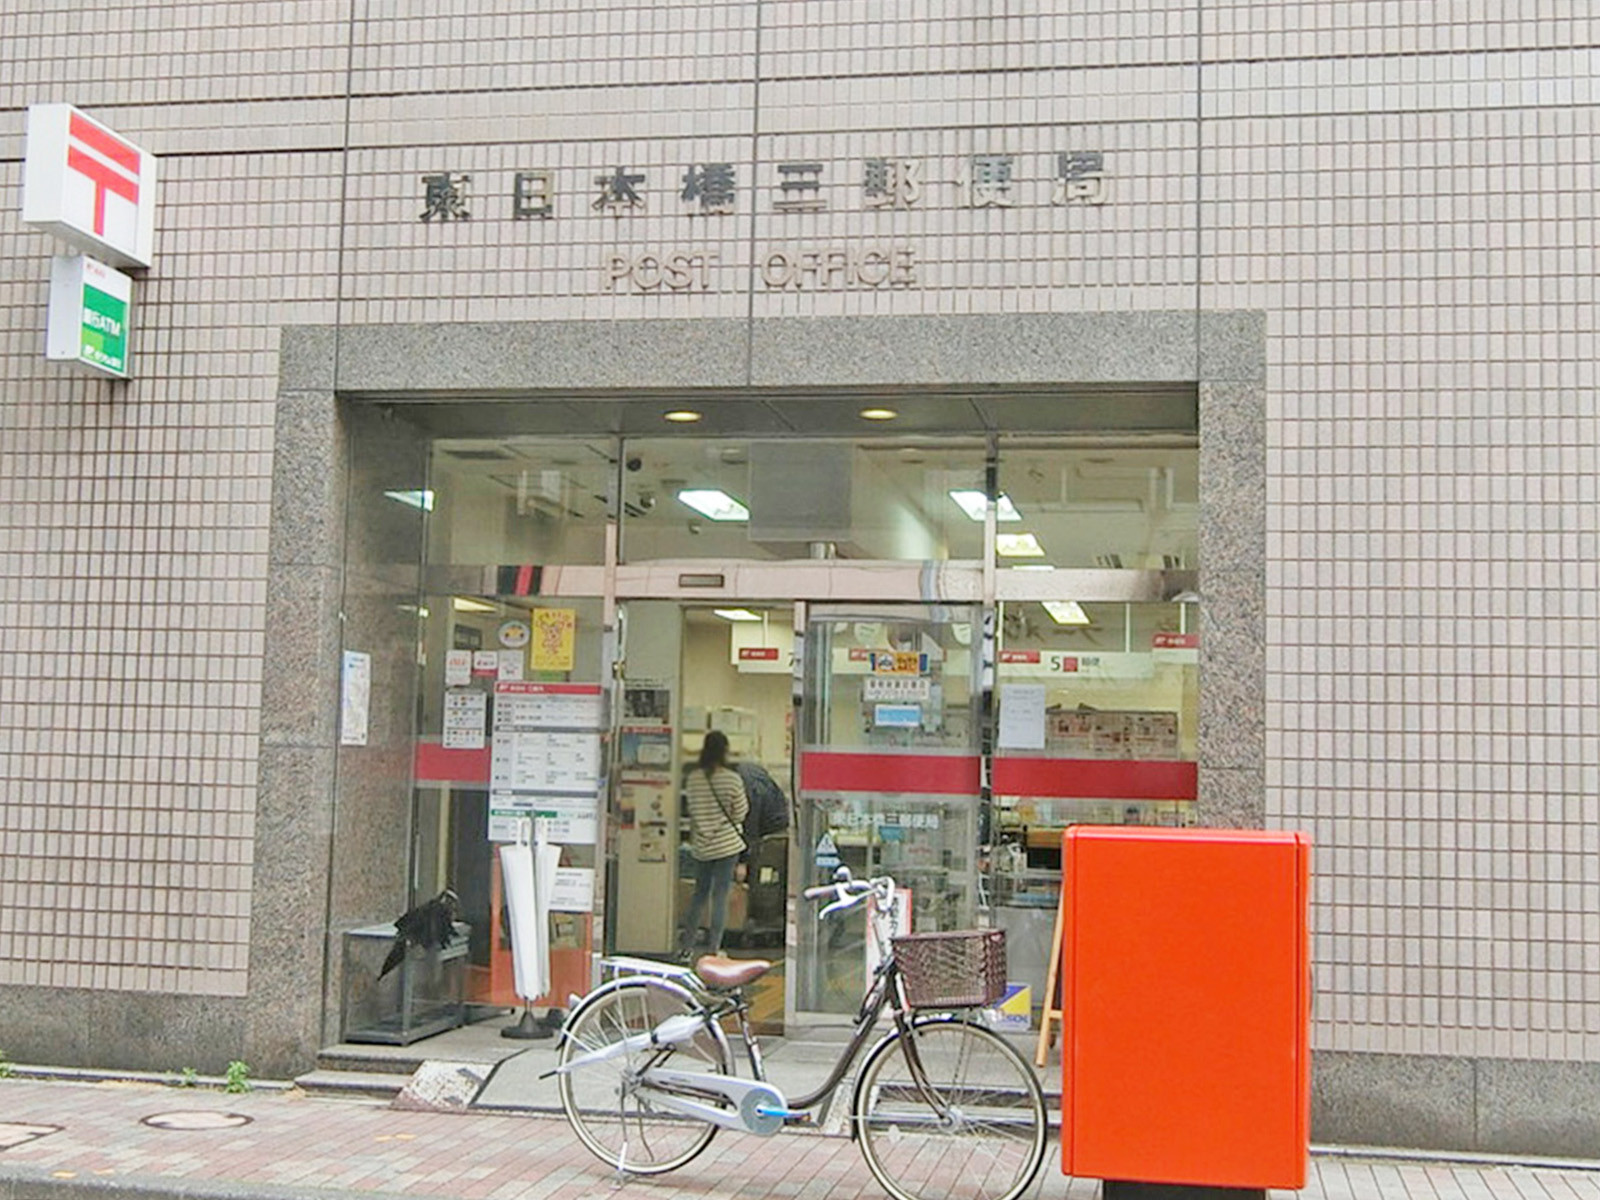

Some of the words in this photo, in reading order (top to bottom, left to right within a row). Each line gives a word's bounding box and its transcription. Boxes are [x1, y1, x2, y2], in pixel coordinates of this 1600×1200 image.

[419, 151, 1108, 223] 東日本橋三郵便局
[603, 249, 719, 291] POST
[760, 250, 917, 289] OFFICE
[1050, 655, 1061, 671] 5
